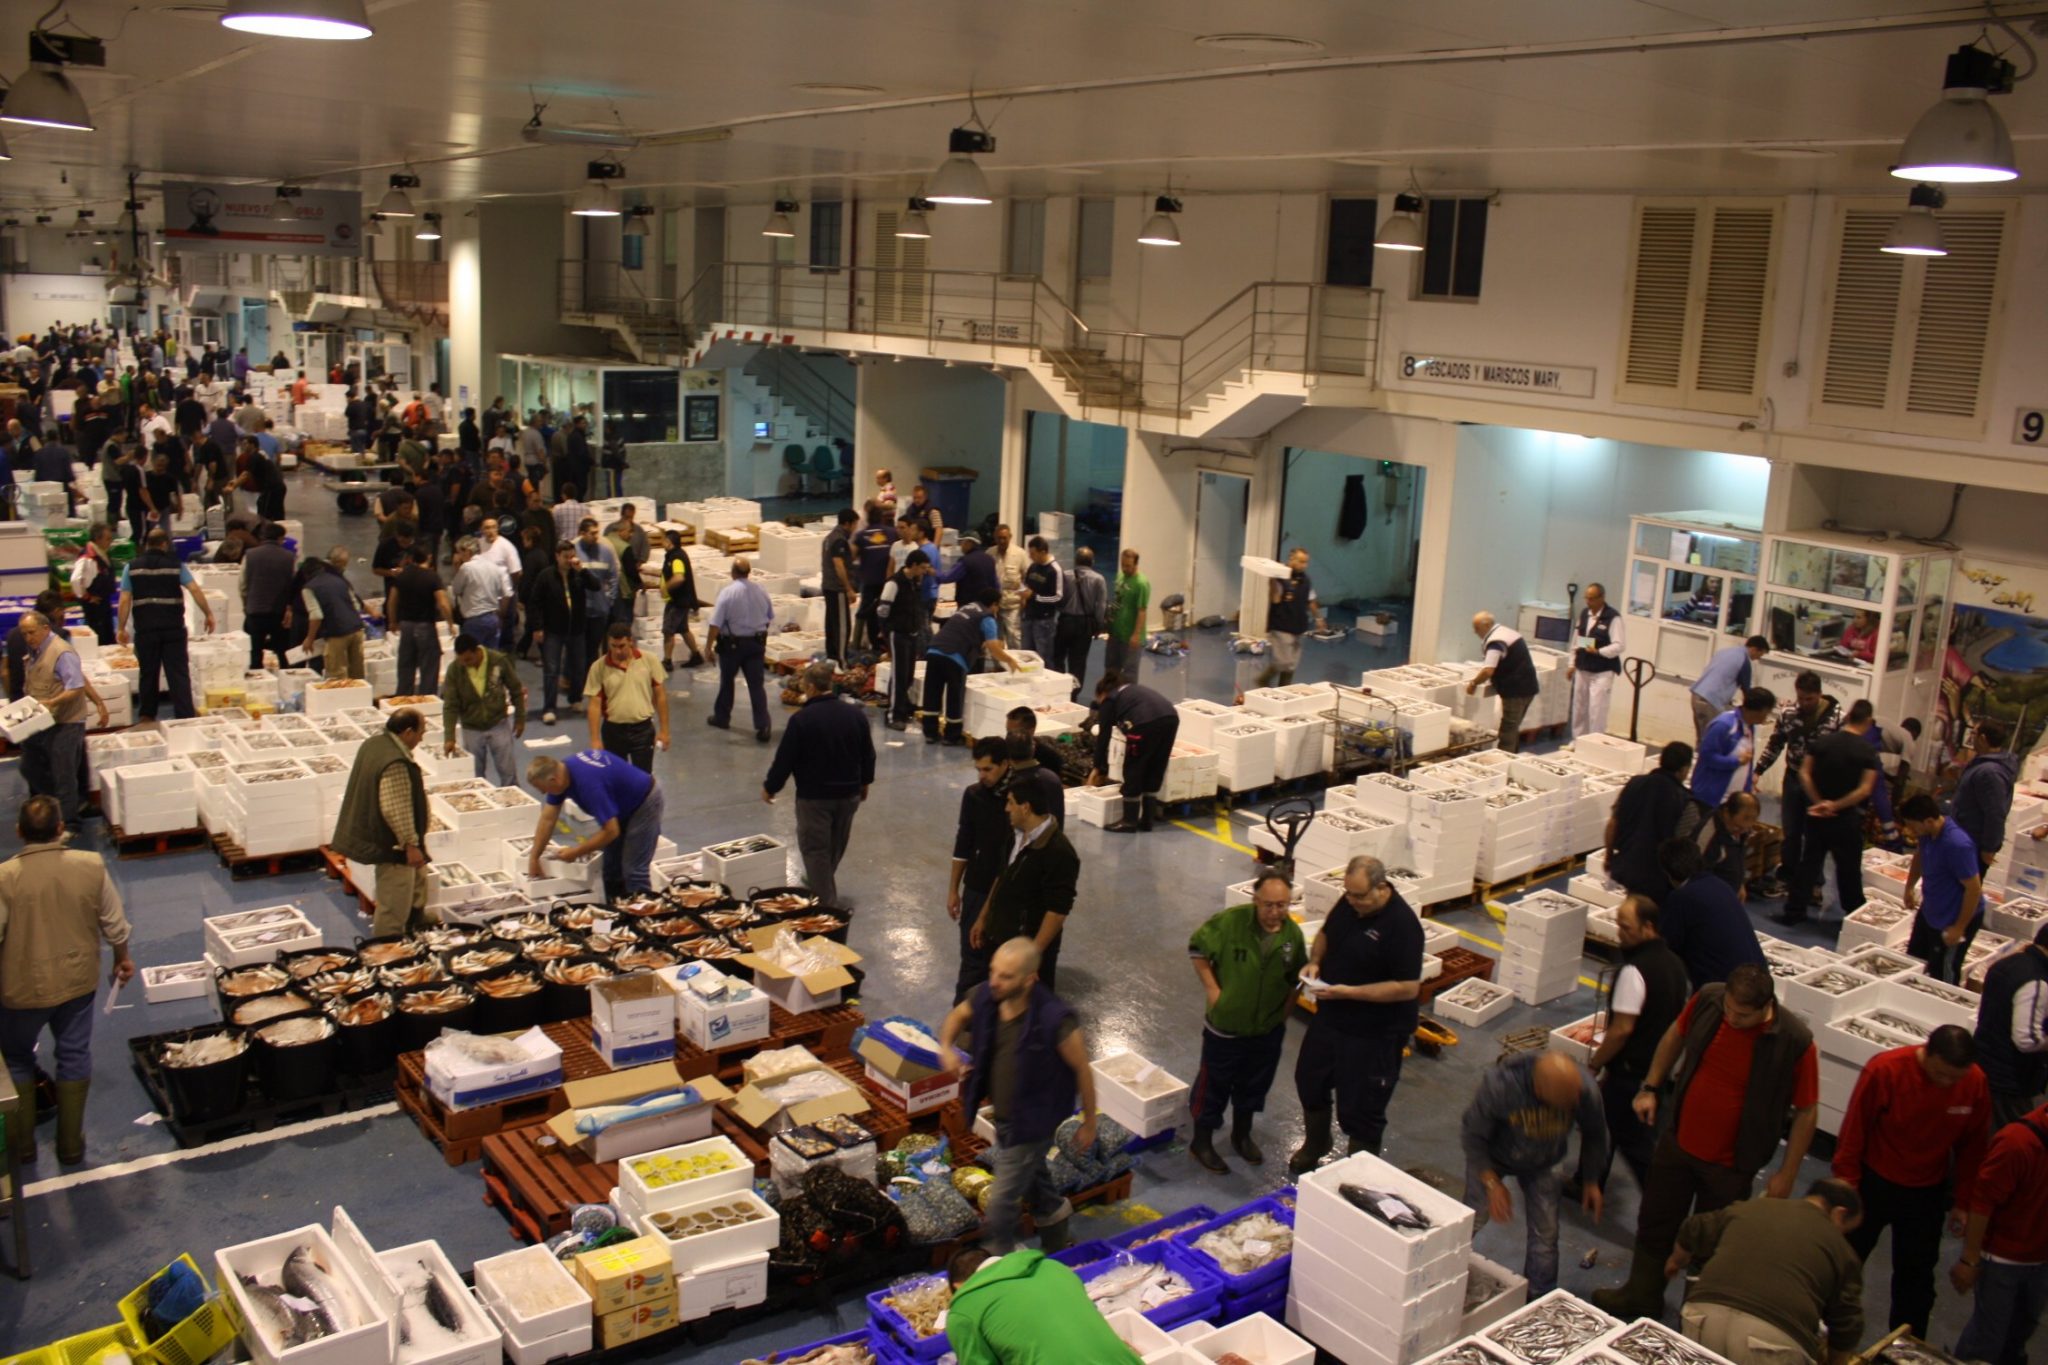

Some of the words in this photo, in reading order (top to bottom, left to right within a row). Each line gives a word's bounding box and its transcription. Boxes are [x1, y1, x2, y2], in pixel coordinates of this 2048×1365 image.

[937, 319, 944, 334] 7
[1404, 355, 1415, 377] 8
[1424, 361, 1471, 380] PESCADOS
[1474, 365, 1480, 380] Y
[1483, 366, 1530, 386] MARISCOS
[2023, 411, 2044, 442] 9
